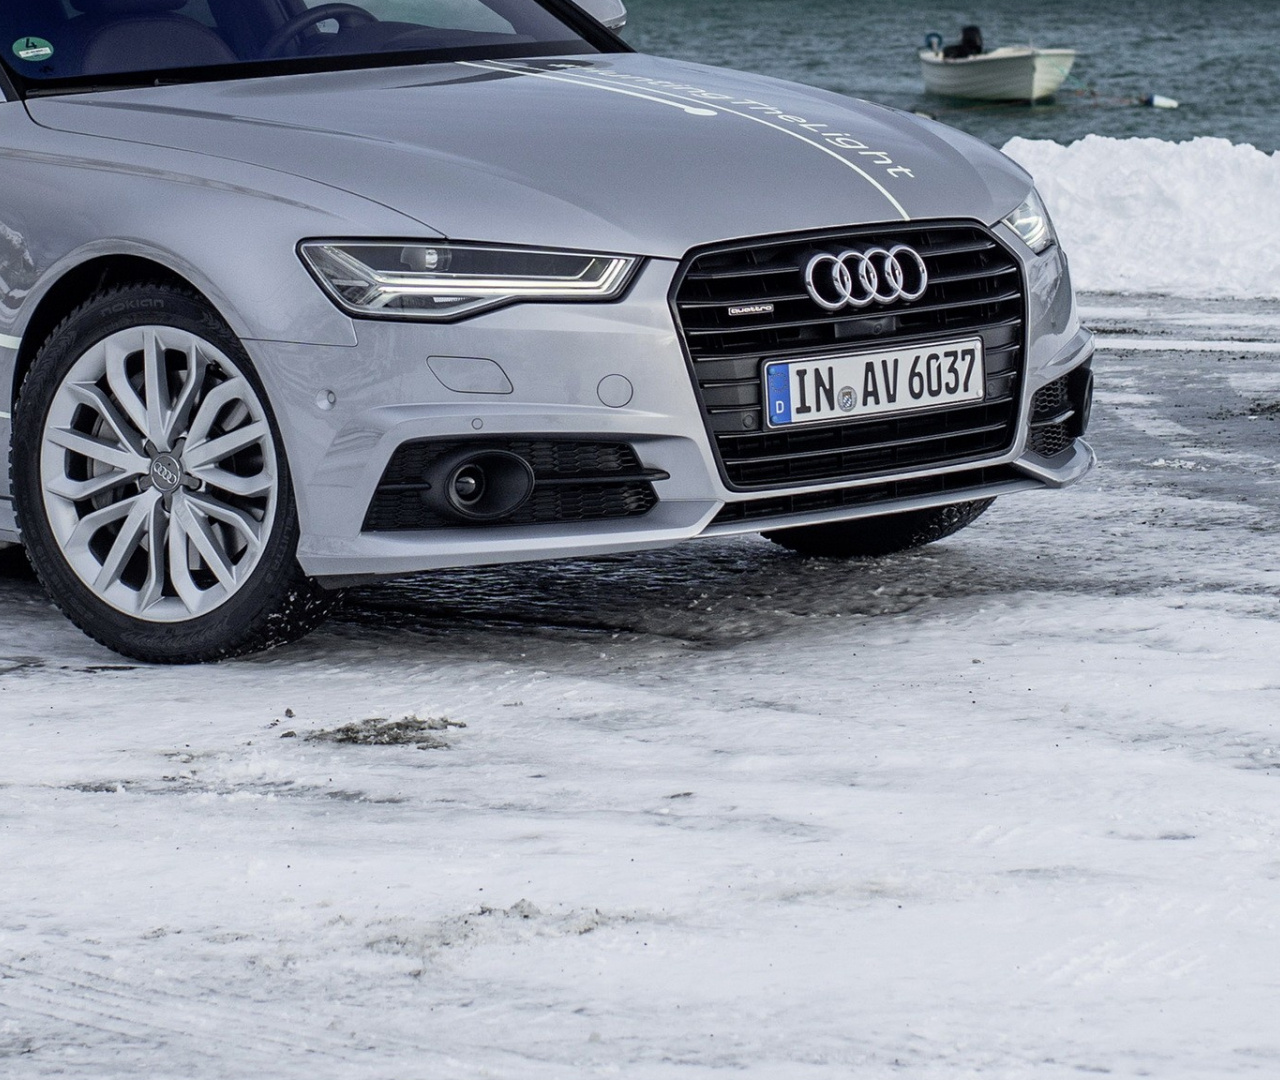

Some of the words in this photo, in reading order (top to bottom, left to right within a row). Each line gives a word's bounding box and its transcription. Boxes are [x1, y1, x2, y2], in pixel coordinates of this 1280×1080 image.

[25, 38, 37, 49] 4
[730, 305, 773, 314] quattro
[795, 366, 835, 414] IN
[862, 358, 899, 406] AV
[908, 348, 975, 400] 6037
[775, 401, 785, 414] D
